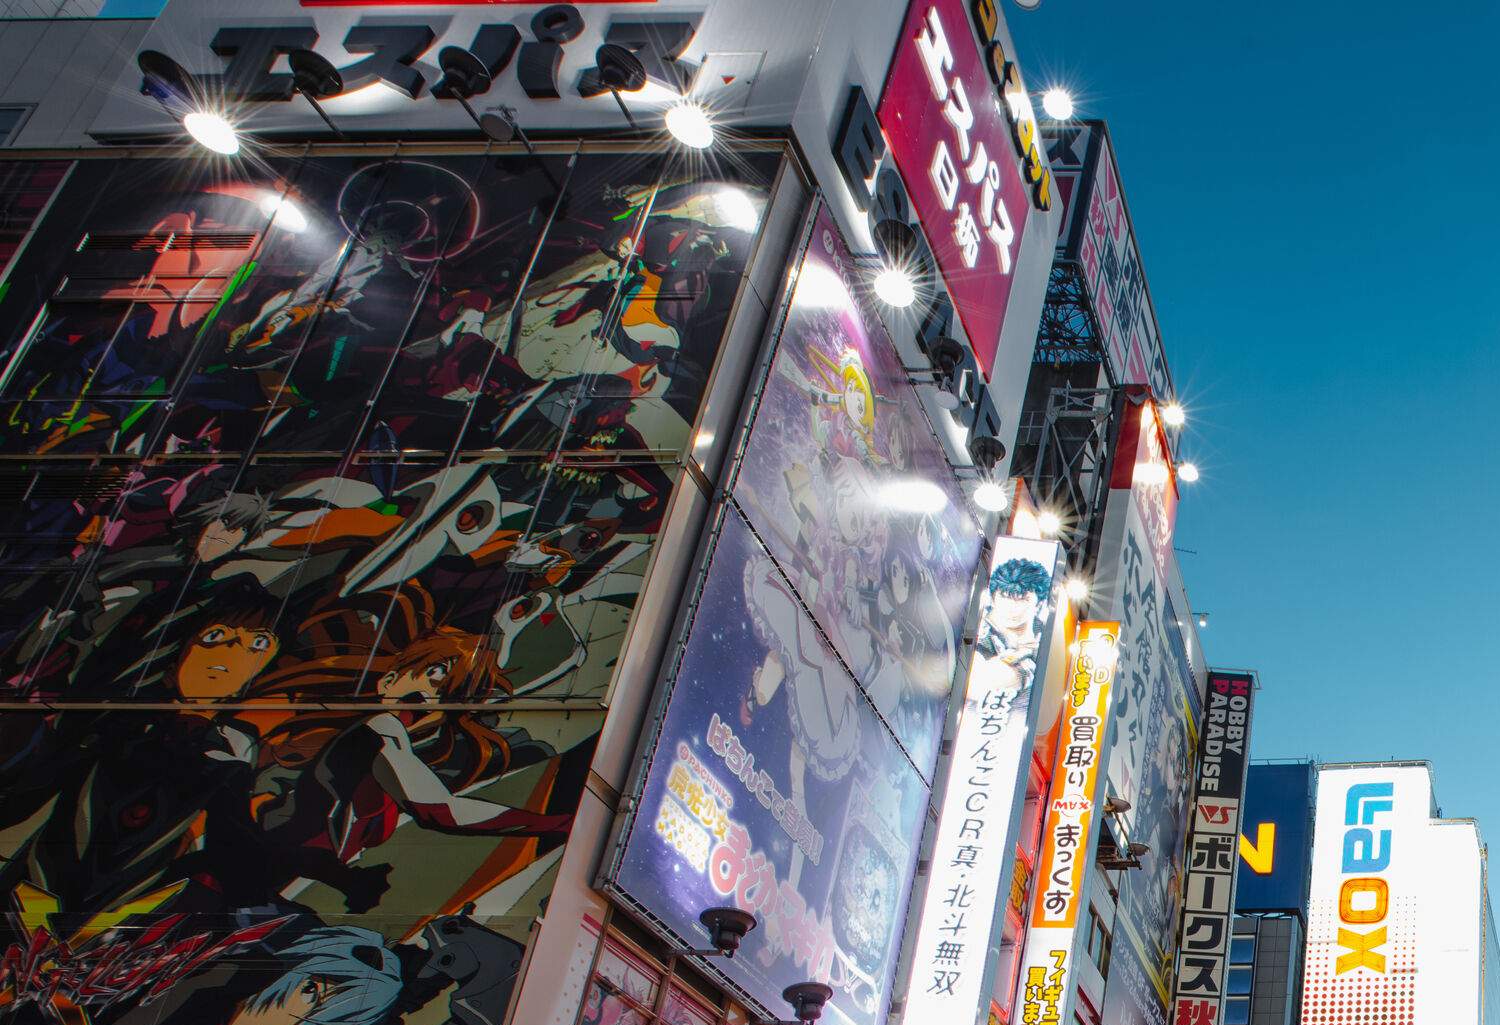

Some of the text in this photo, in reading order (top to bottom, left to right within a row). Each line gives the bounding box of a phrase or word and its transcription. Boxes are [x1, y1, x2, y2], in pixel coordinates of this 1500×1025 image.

[208, 3, 702, 101] エスパス
[1064, 714, 1101, 786] 買取り
[1200, 678, 1229, 792] PARADISE
[1226, 679, 1249, 756] HOBBY
